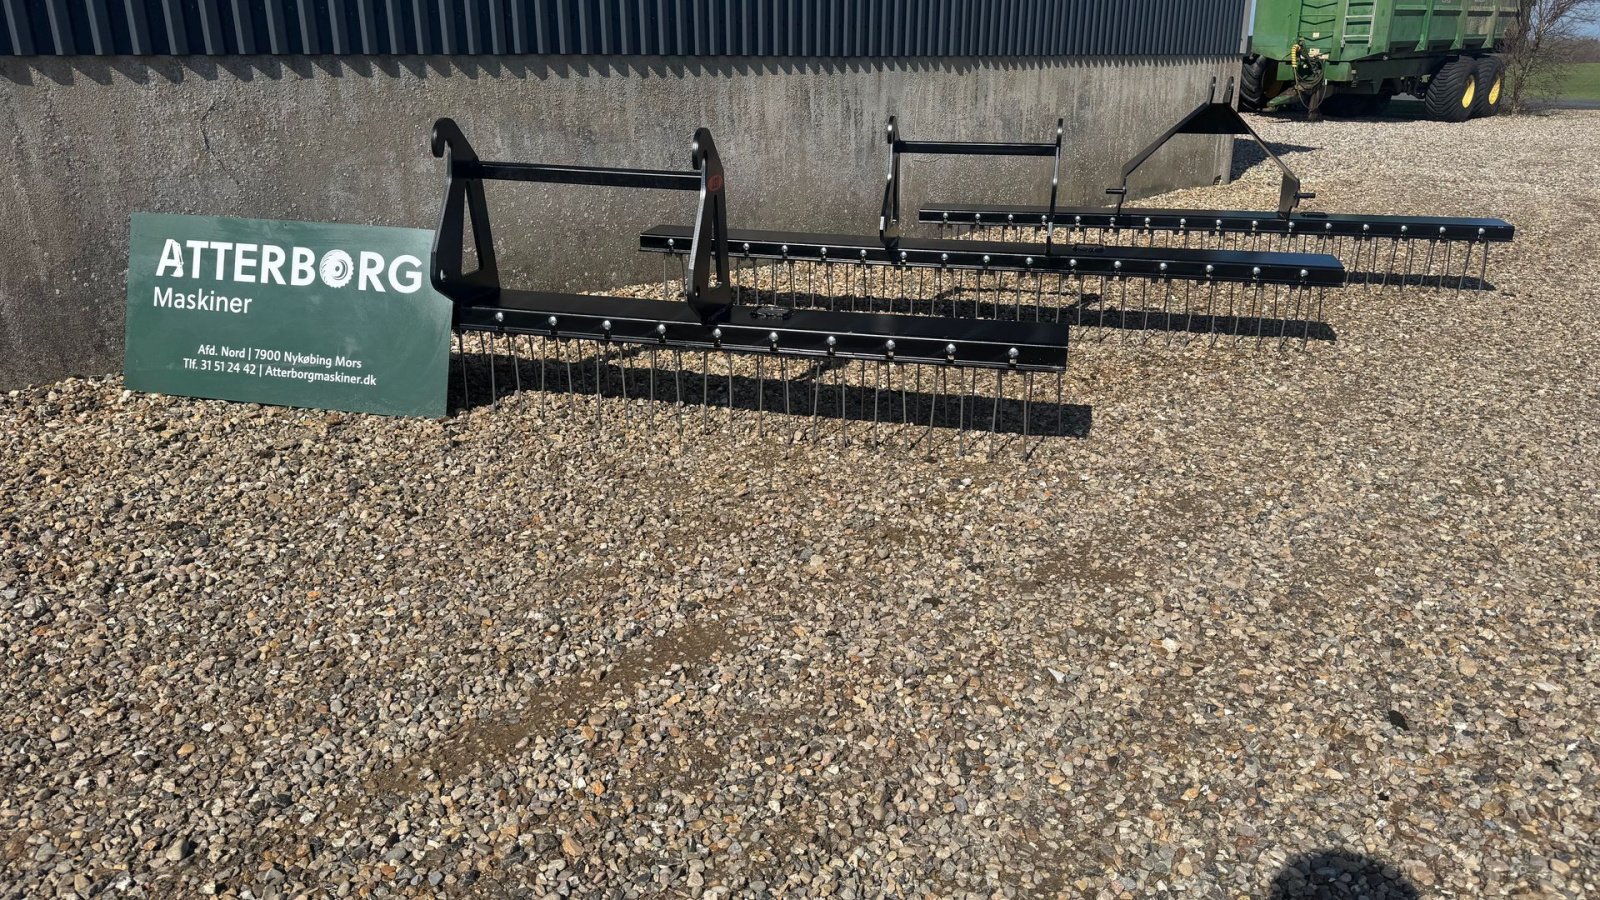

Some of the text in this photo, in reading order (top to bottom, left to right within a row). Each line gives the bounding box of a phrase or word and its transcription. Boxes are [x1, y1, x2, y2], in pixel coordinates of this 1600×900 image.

[156, 239, 422, 293] ATTERBORG
[153, 286, 252, 314] Maskiner
[197, 344, 218, 357] Afd.
[221, 345, 245, 359] Nord
[254, 349, 281, 362] 7900
[284, 351, 332, 369] Nykøbing
[335, 355, 362, 369] Mors
[183, 357, 199, 370] Tlf.
[201, 359, 212, 371] 31
[214, 360, 224, 372] 51
[227, 362, 240, 374] 24
[243, 363, 256, 375] 42
[265, 365, 377, 386] Atterborgmaskiner.dk
